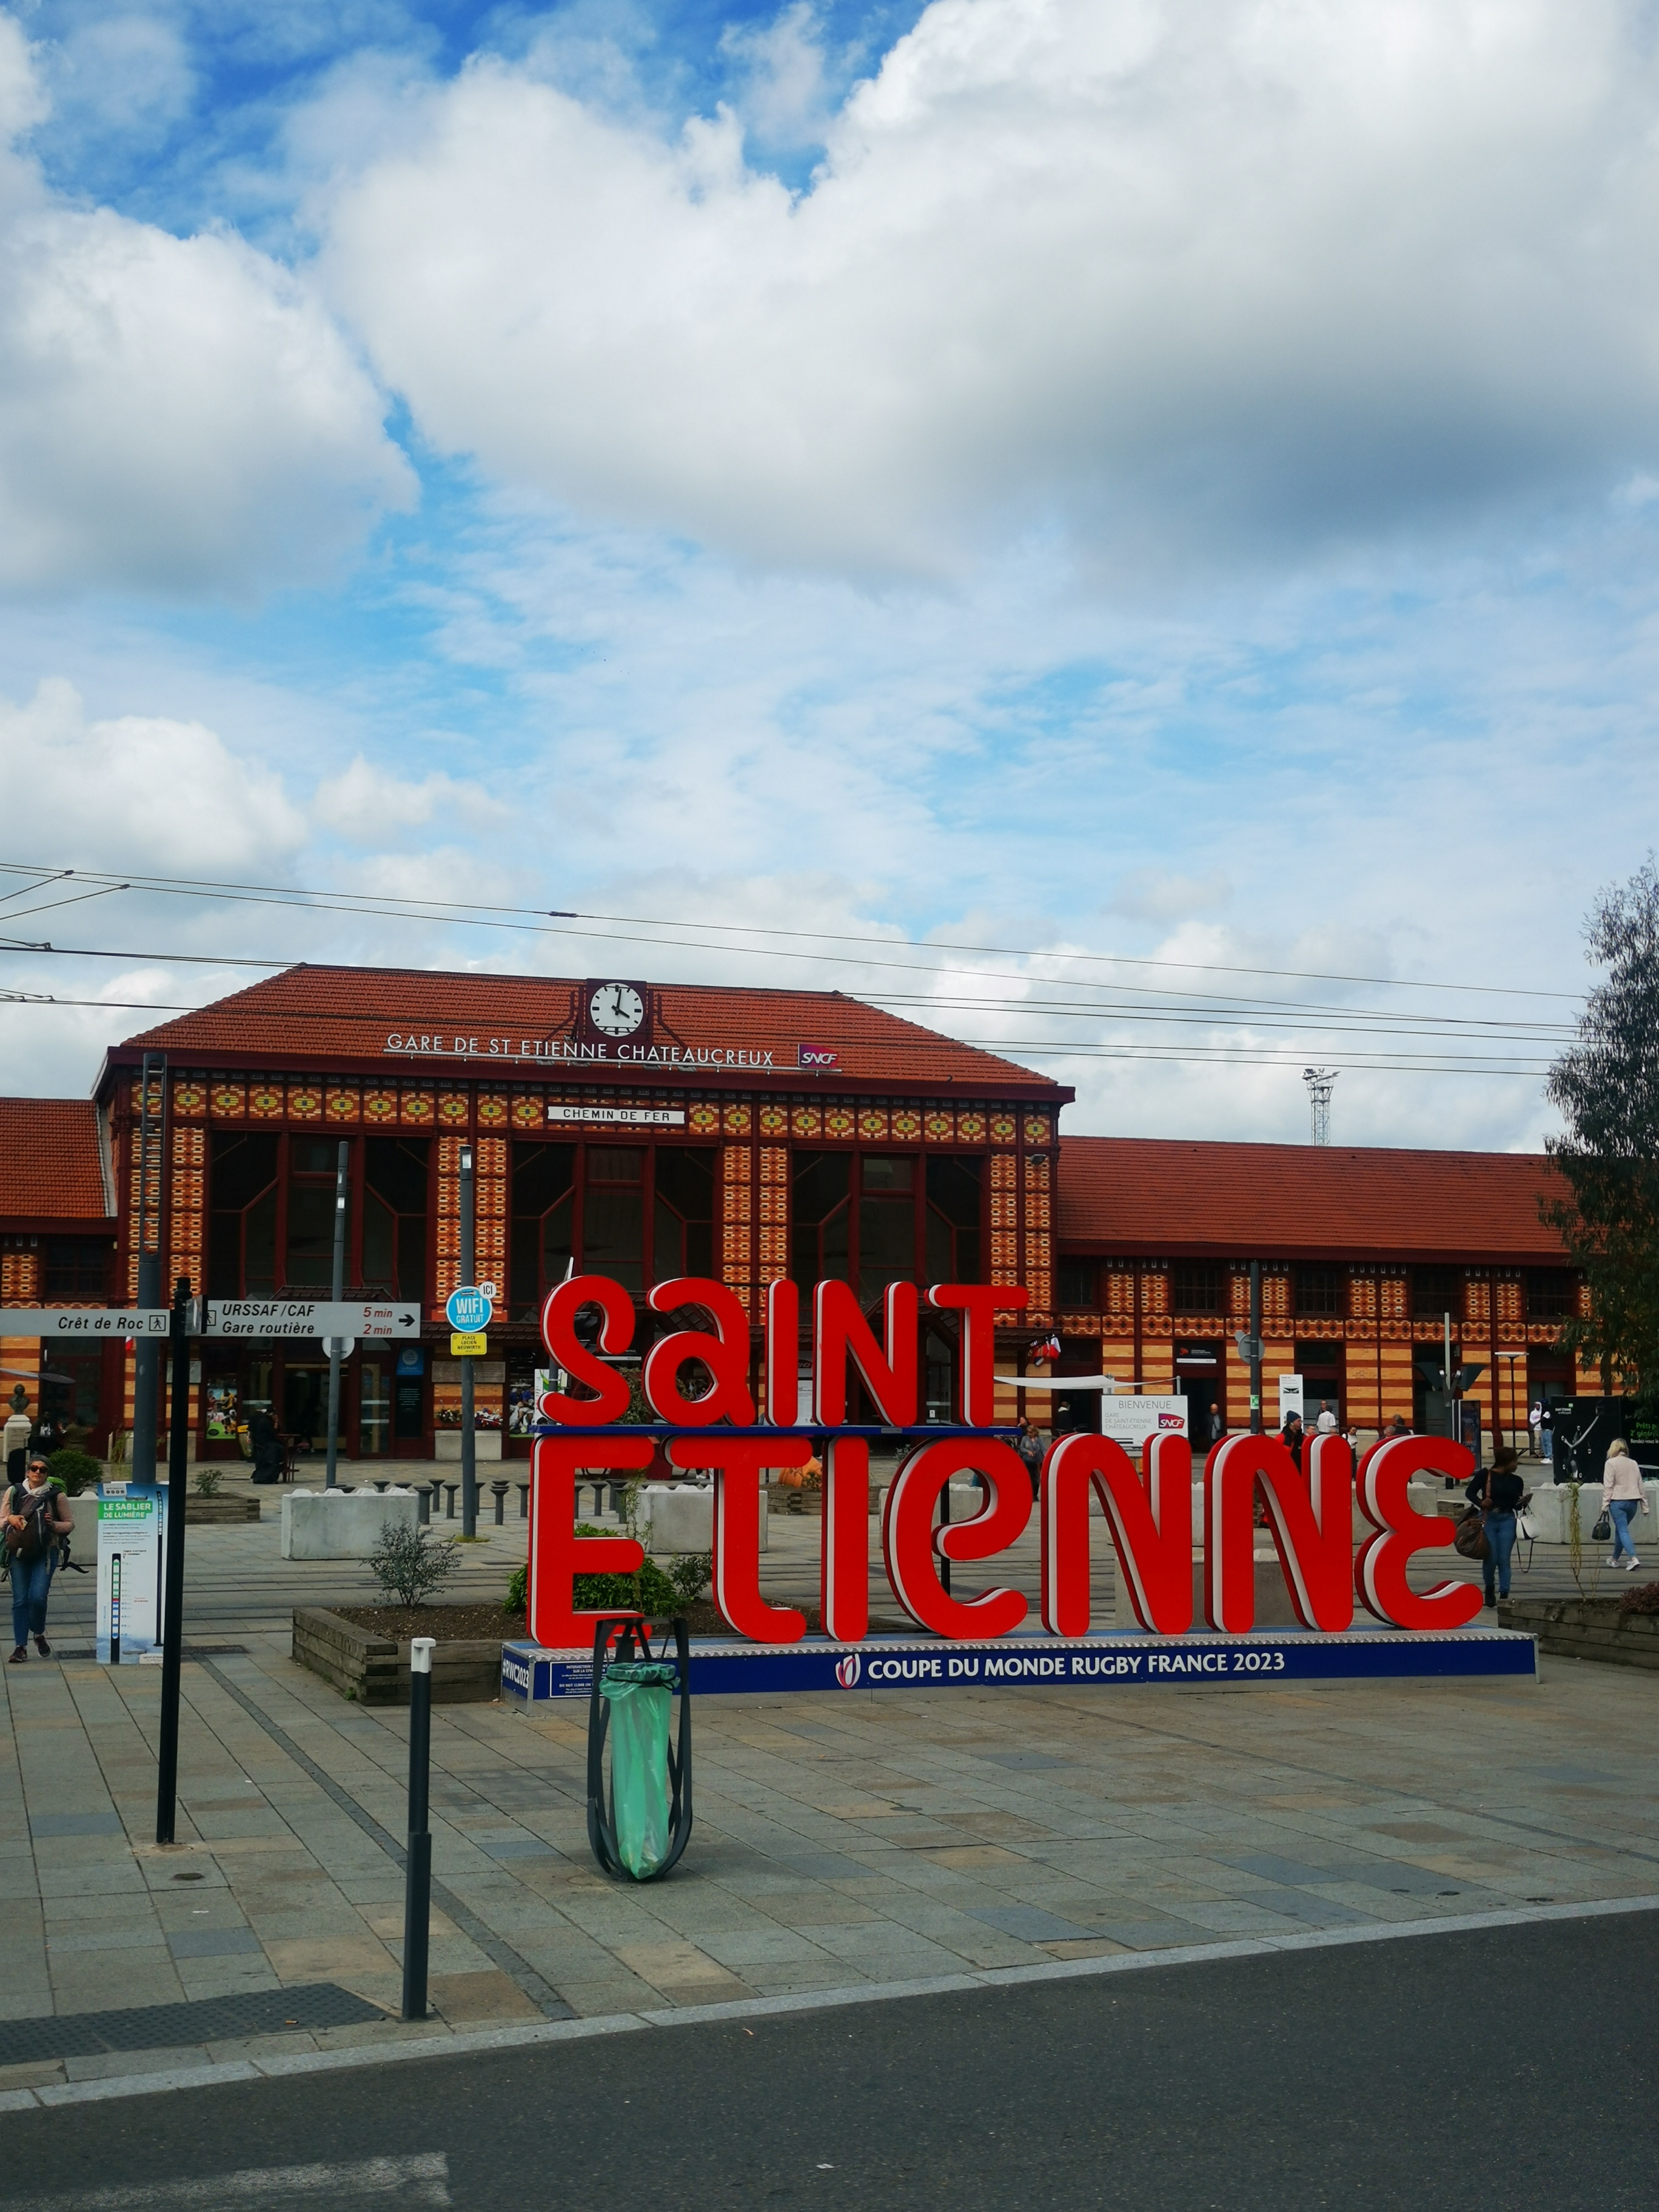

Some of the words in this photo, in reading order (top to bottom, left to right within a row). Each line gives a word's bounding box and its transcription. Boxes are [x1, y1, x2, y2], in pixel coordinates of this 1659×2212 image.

[387, 1033, 443, 1051] GARE
[455, 1037, 478, 1053] DE
[489, 1038, 512, 1054] ST
[521, 1040, 607, 1059] ETIENNE
[617, 1044, 774, 1066] CHATEAUCREUX
[801, 1052, 838, 1065] SNCF
[563, 1108, 614, 1120] CHEMIN
[620, 1111, 637, 1121] DE
[645, 1112, 669, 1122] FER
[483, 1285, 493, 1295] ICI
[363, 1307, 372, 1318] 5
[374, 1309, 393, 1318] min
[456, 1298, 483, 1314] WIFI
[58, 1316, 89, 1329] Crêt
[95, 1316, 111, 1329] de
[117, 1317, 143, 1329] Roc
[456, 1314, 484, 1324] GRATUIT
[222, 1321, 254, 1333] Gare
[260, 1321, 314, 1334] routière
[363, 1324, 372, 1335] 2
[374, 1326, 392, 1335] min
[1118, 1400, 1171, 1409] BIENVENUE
[868, 1658, 942, 1680] COUPE
[948, 1658, 979, 1677] DU
[984, 1656, 1066, 1677] MONDE
[1071, 1655, 1142, 1675] RUGBY
[1148, 1653, 1228, 1674] FRANCE
[1233, 1652, 1285, 1671] 2023
[503, 1658, 529, 1689] #RWC2023
